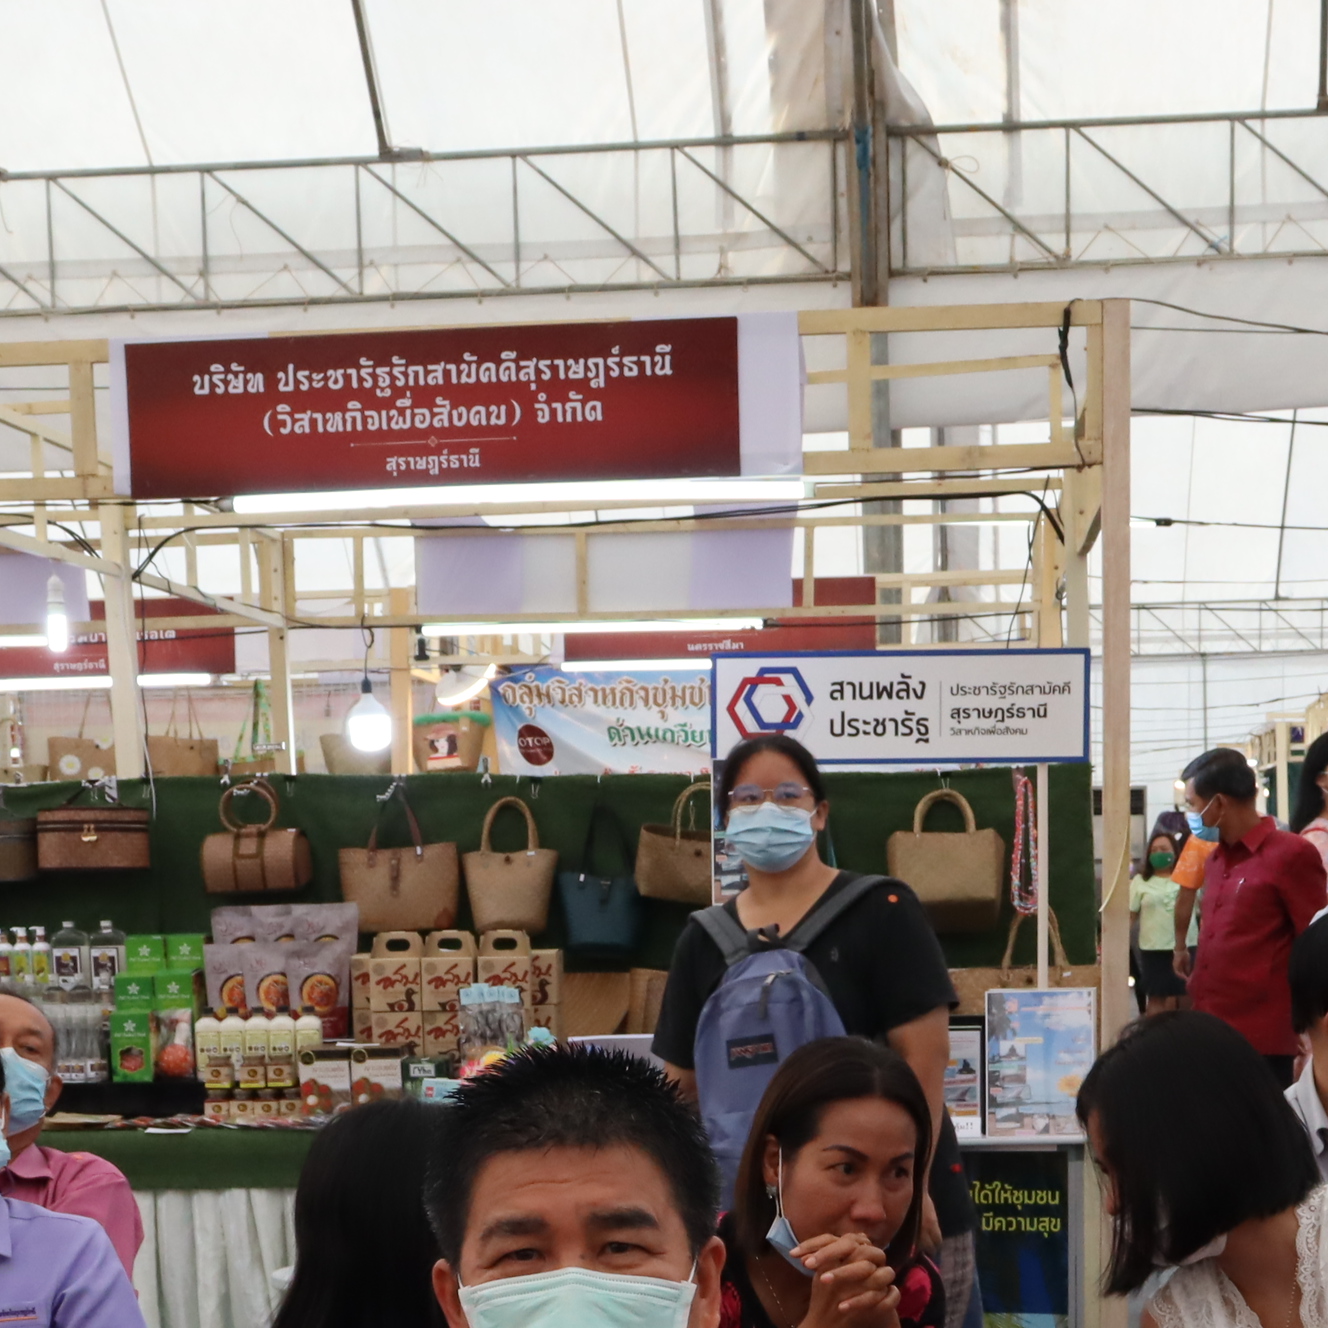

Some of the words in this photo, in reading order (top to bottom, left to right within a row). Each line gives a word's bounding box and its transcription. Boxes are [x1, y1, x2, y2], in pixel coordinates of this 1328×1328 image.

[193, 362, 265, 396] บริษัท
[277, 345, 674, 398] ประชารัฐรักสามัคคีสุราษฎร์ธานี
[262, 390, 522, 437] (วิสาหกิจเพื่อสังคม)
[535, 392, 603, 424] จำกัด
[385, 448, 482, 476] สุราษฎร์ธานี
[829, 672, 927, 701] สานพลัง
[950, 681, 1072, 700] ประชารัฐรักสามัคคี
[829, 709, 930, 744] ประชารัฐ
[950, 702, 1048, 725] สุราษฎร์ธานี
[519, 736, 551, 748] OTOP
[950, 724, 1029, 737] วิสาหกิจเพื่อสังคม
[981, 1211, 1061, 1239] มีความสุข
